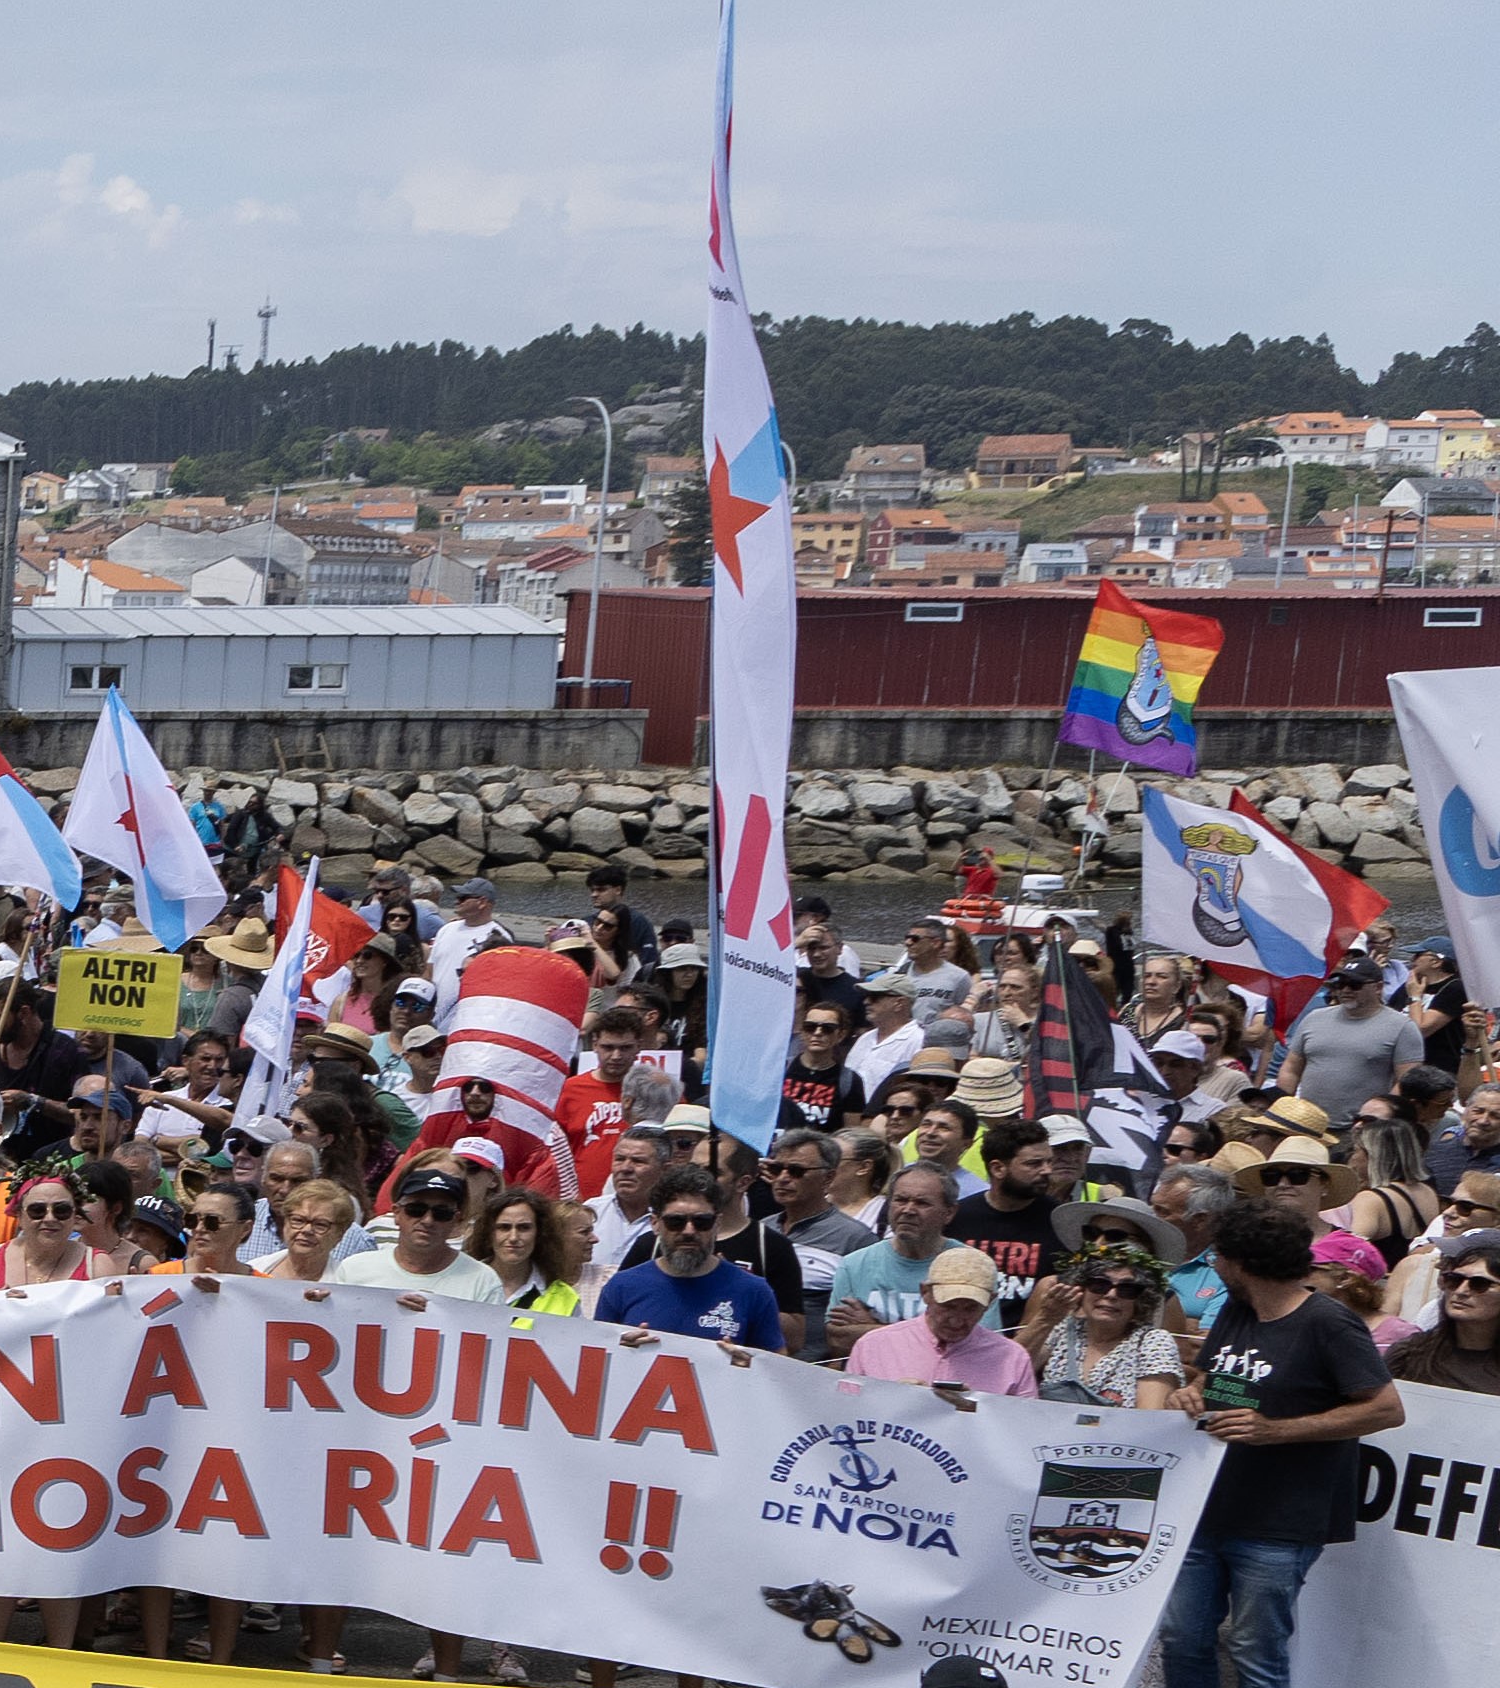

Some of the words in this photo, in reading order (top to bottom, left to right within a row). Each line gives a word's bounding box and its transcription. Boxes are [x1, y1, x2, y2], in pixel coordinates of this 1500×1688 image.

[82, 957, 157, 983] ALTRI
[89, 984, 147, 1008] NON
[263, 1321, 717, 1455] RUINA
[769, 1423, 832, 1484] CONFRARIA
[856, 1419, 877, 1435] DE
[881, 1422, 969, 1485] PESCADORES
[1052, 1444, 1161, 1464] PORTOSIN
[322, 1423, 541, 1563] RÍA
[792, 1482, 831, 1500] SAN
[839, 1490, 956, 1527] BARTOLOMÉ
[761, 1499, 804, 1525] DE
[811, 1501, 960, 1558] NOIA
[1010, 1515, 1049, 1584] CONFRARIA
[1061, 1581, 1081, 1593] DE
[1095, 1529, 1174, 1594] PESCADORES
[920, 1614, 1122, 1660] MEXILLOEIROS
[1066, 1661, 1111, 1686] SL"
